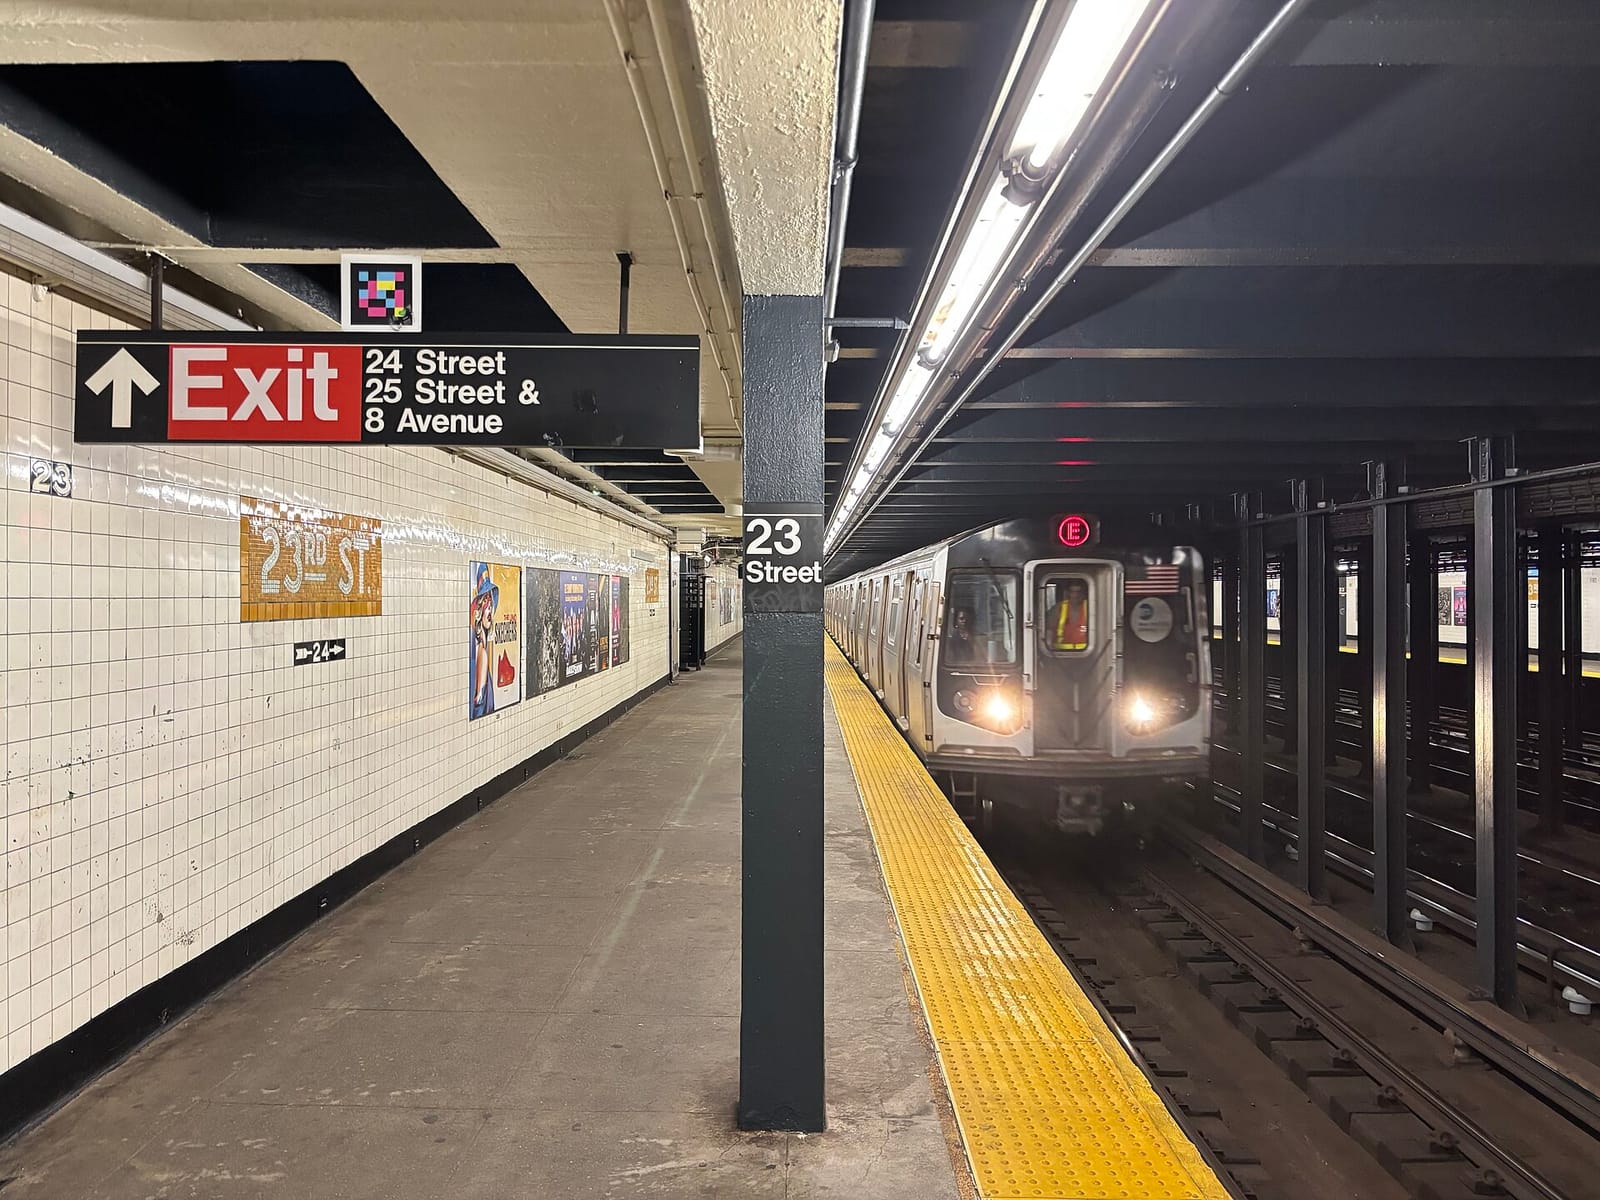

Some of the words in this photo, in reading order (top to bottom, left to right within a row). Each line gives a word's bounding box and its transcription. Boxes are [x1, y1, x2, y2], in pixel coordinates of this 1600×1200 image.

[365, 349, 403, 374] 24
[415, 349, 507, 375] Street
[172, 347, 338, 421] Exit
[365, 378, 403, 403] 25
[415, 378, 506, 404] Street
[518, 379, 541, 405] &
[364, 407, 385, 433] 8
[396, 407, 503, 433] Avenue
[32, 460, 71, 497] 23
[746, 518, 802, 555] 23
[262, 526, 327, 594] 23RD
[746, 561, 822, 583] Street
[312, 642, 330, 663] 24
